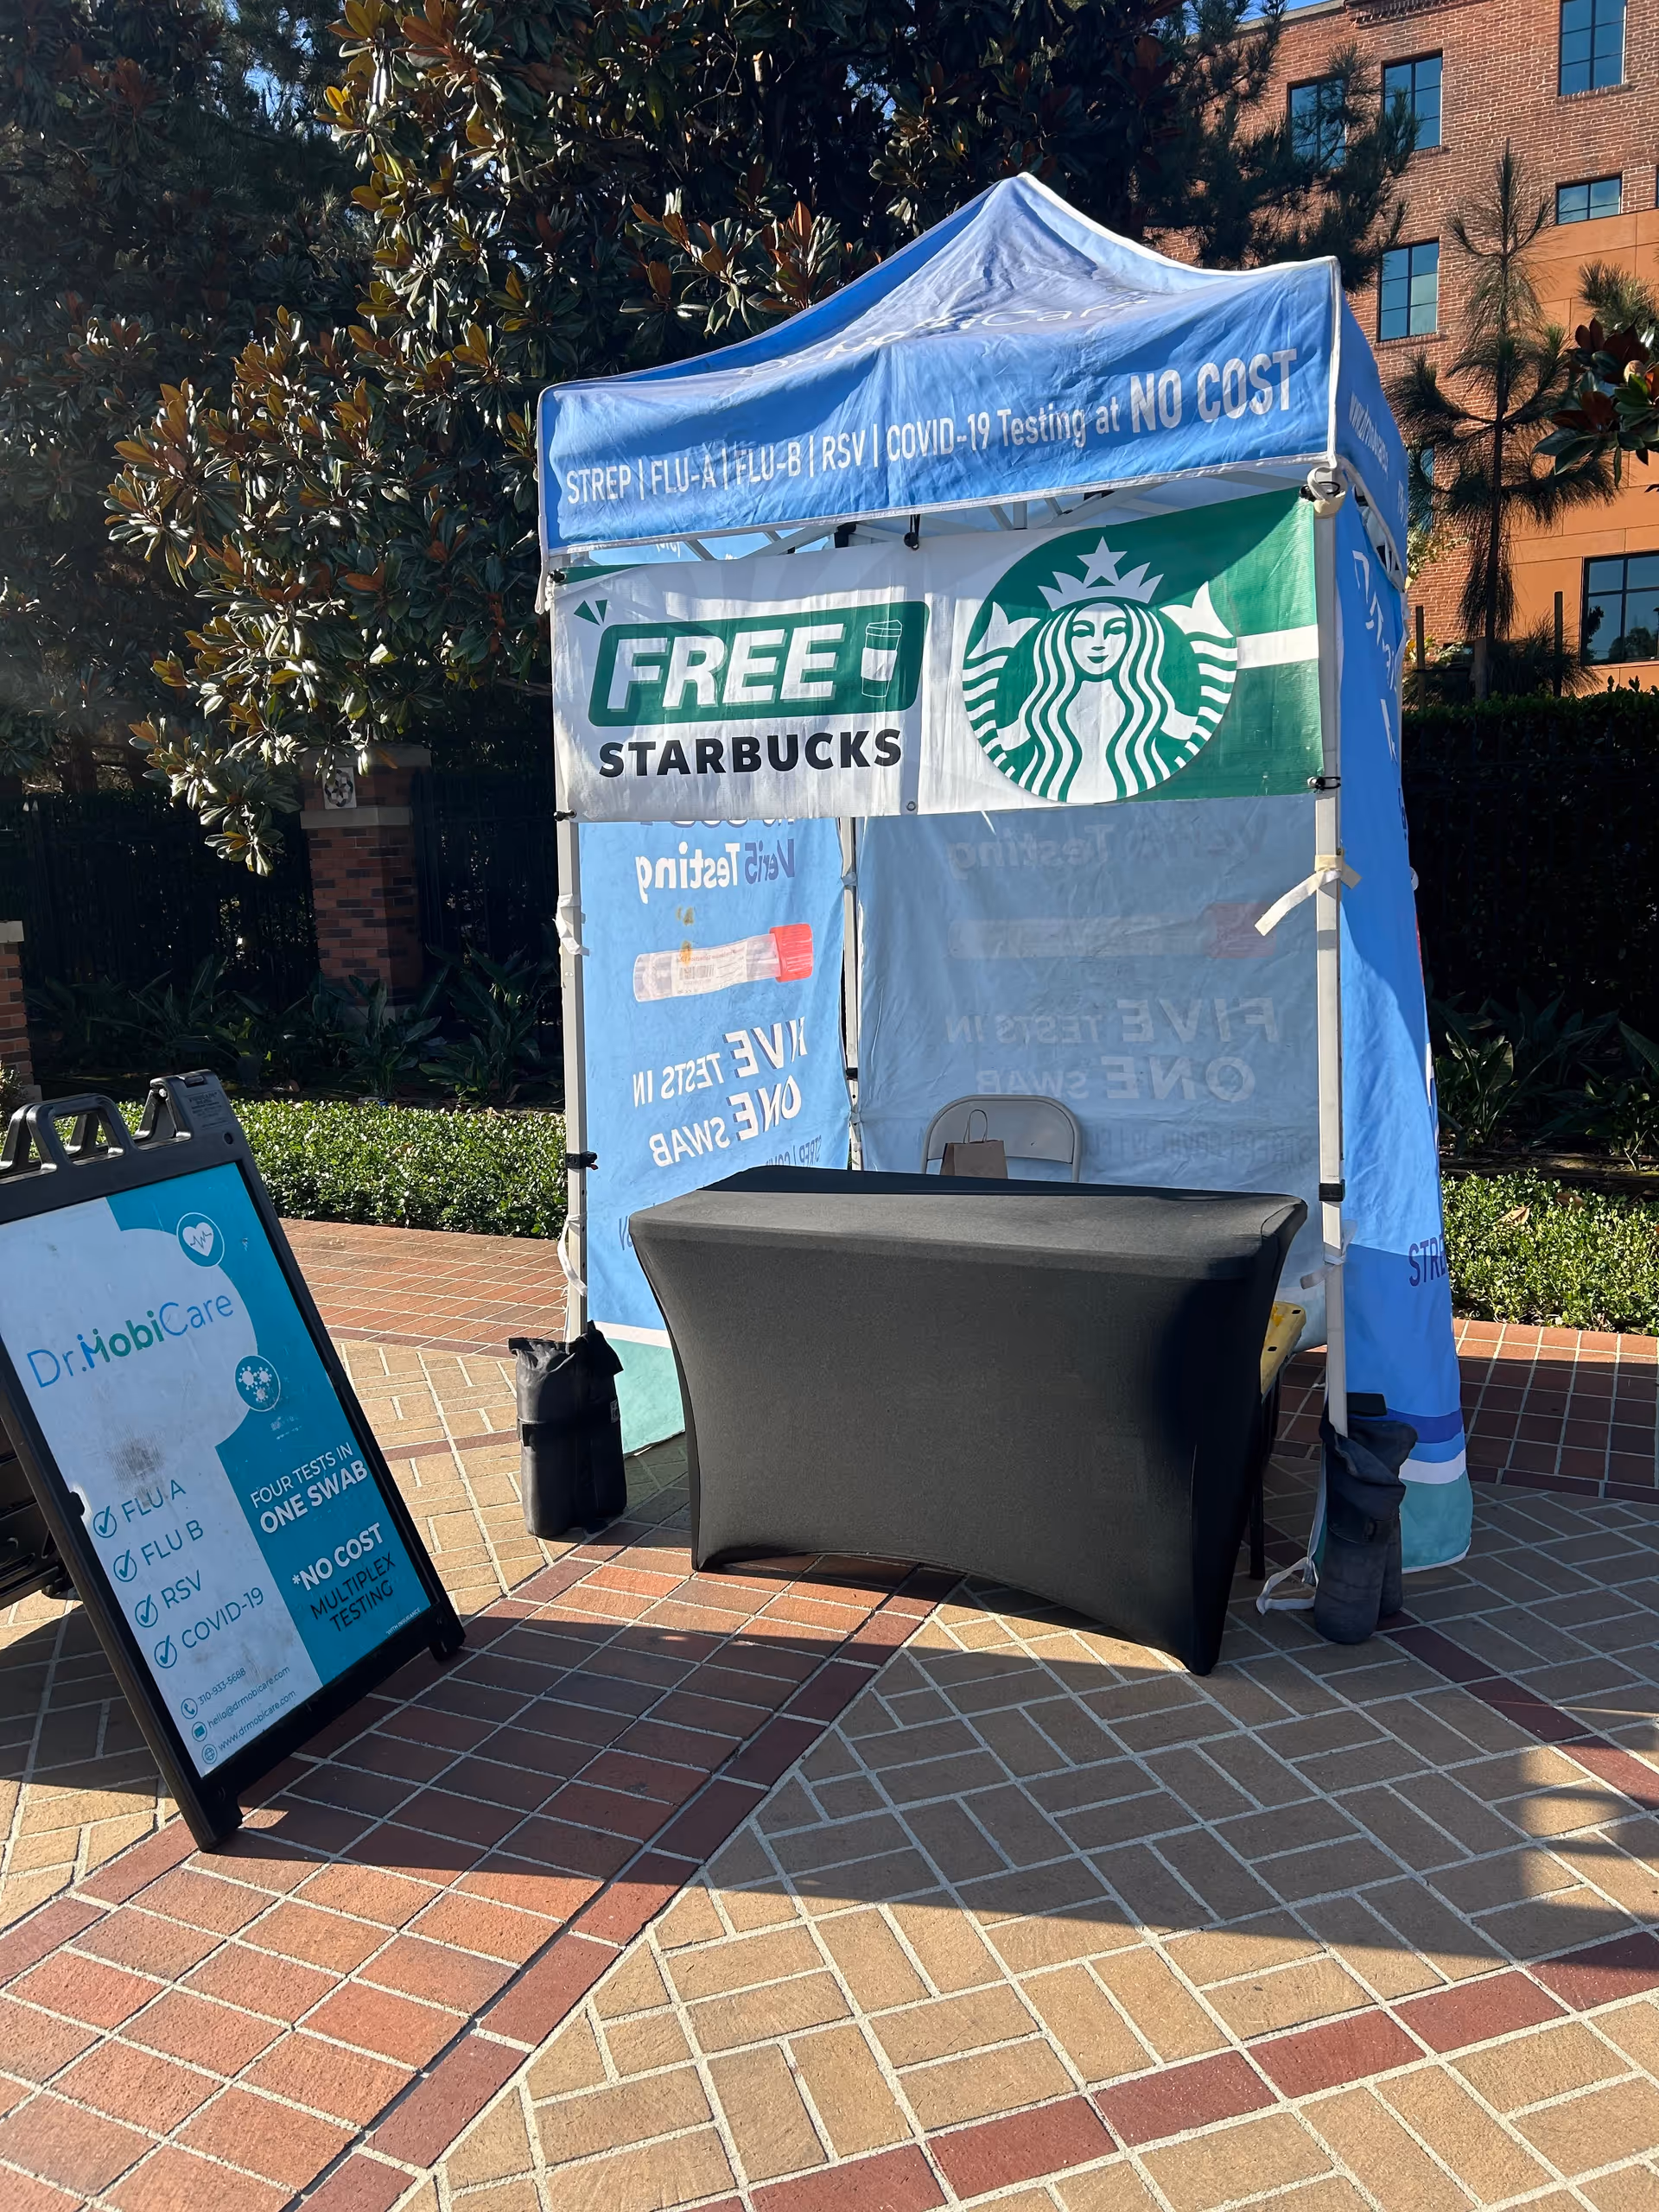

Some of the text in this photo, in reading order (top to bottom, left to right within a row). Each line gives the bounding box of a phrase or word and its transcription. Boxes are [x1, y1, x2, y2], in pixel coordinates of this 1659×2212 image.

[566, 464, 632, 505] STREP
[651, 454, 716, 495] FLU-A
[735, 442, 801, 485] FLU-B
[822, 429, 865, 471] RSV
[887, 412, 990, 461] COVID-19
[997, 403, 1086, 448] Testing
[1096, 396, 1120, 435] at
[1129, 369, 1182, 434] NO
[1197, 348, 1296, 423] COST
[607, 623, 847, 712] FREE
[599, 728, 902, 778] STARBUCKS
[27, 1295, 233, 1388] Dr.MobiCare
[121, 1479, 187, 1523] FLU A
[251, 1442, 353, 1509] FOUR TESTS IN
[261, 1459, 368, 1534] ONE SWAB
[141, 1520, 204, 1566] FLU B
[334, 1522, 384, 1567] COST
[161, 1569, 201, 1609] RSV
[310, 1552, 396, 1620] MULTIPLEX
[329, 1580, 394, 1632] TESTING
[181, 1587, 264, 1649] COVID-19
[197, 1667, 246, 1706] 310-933-5688
[207, 1666, 290, 1728] hello@drmobicare.com
[218, 1689, 296, 1751] www.drmobicare.com
